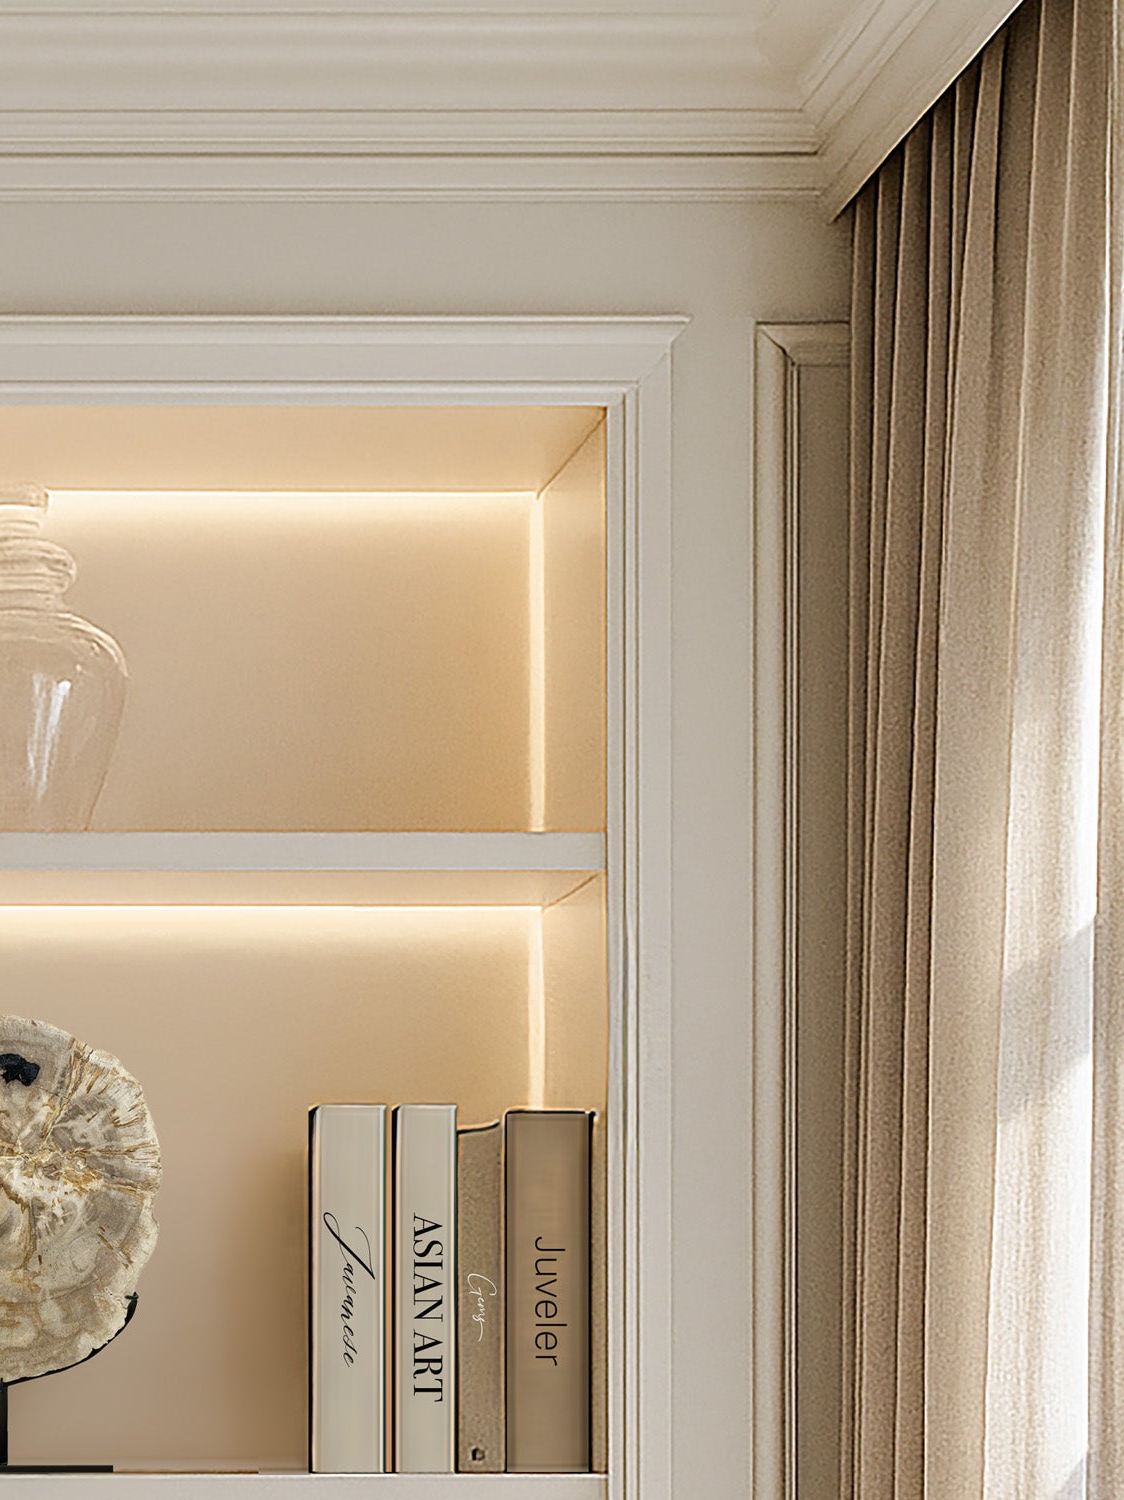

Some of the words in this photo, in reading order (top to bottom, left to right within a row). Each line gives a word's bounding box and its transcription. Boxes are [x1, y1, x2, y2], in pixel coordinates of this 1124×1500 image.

[323, 1211, 376, 1368] Javanese
[412, 1214, 444, 1322] ASIAN
[534, 1235, 568, 1367] Juveler
[412, 1330, 444, 1403] ART
